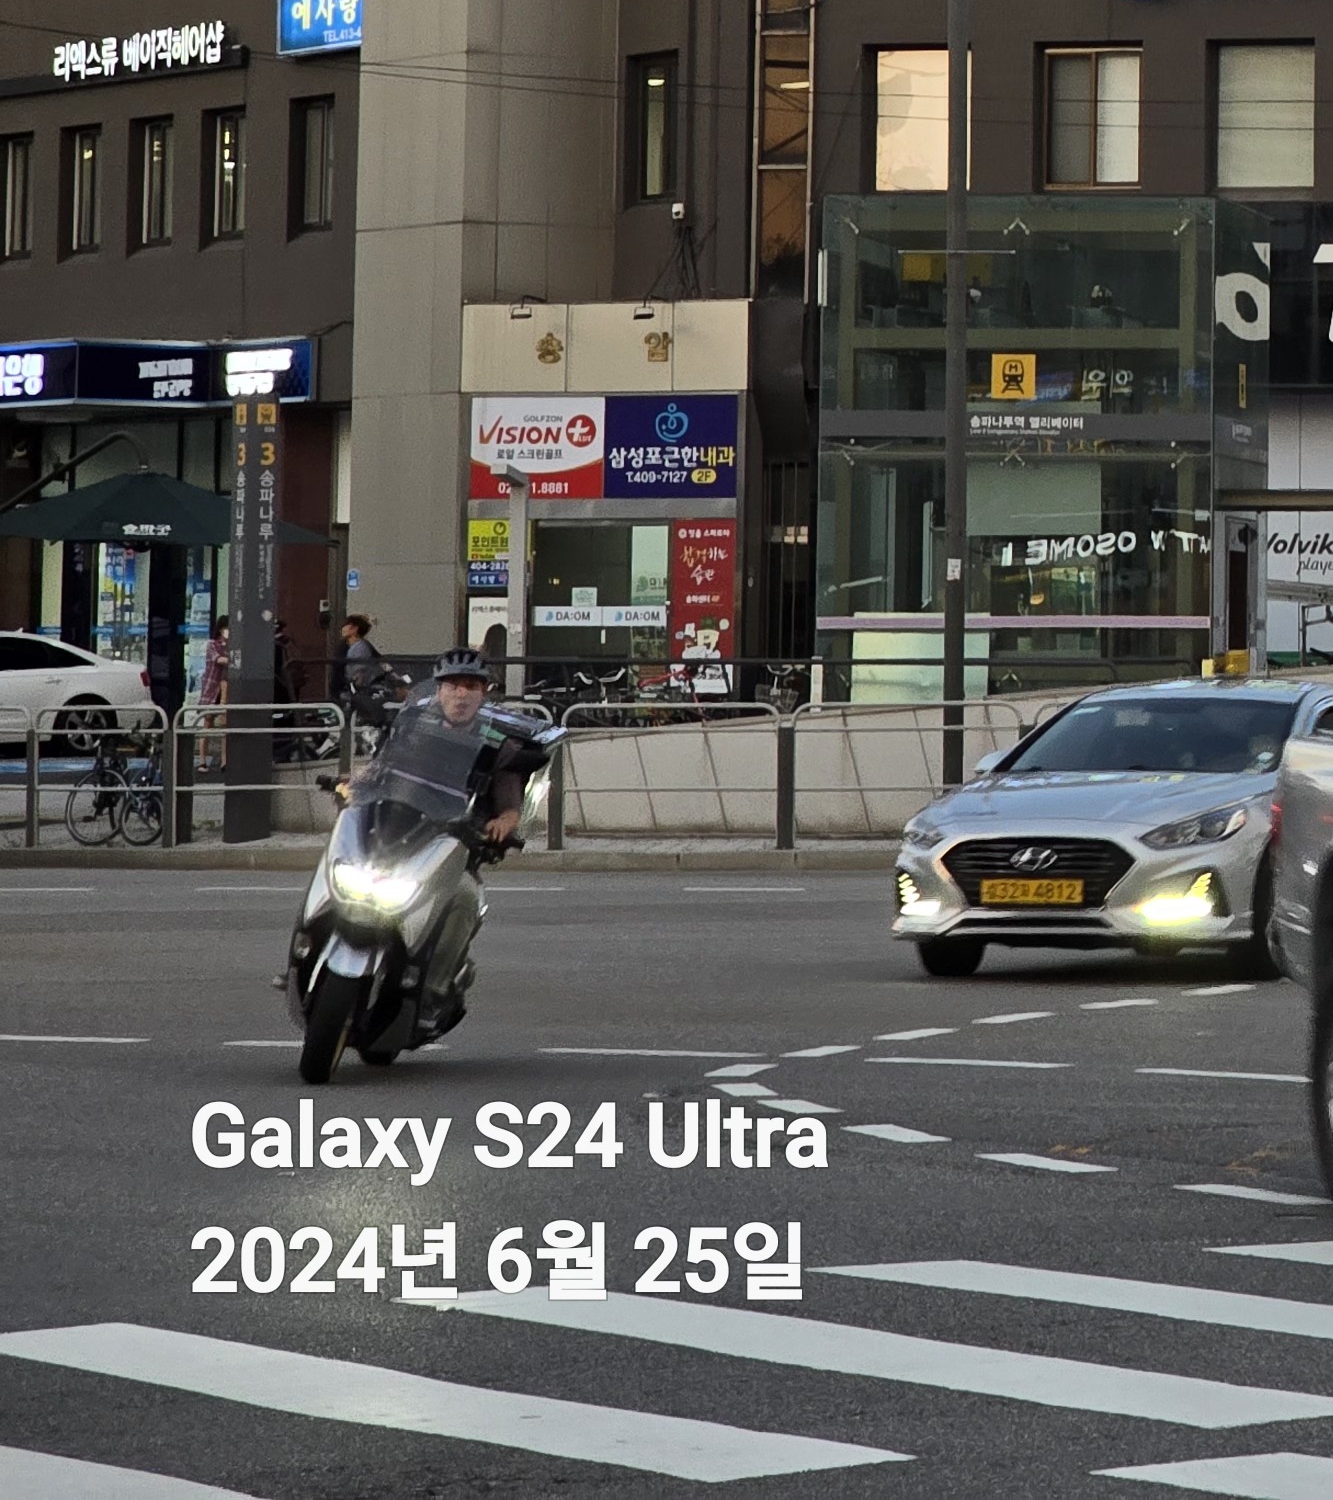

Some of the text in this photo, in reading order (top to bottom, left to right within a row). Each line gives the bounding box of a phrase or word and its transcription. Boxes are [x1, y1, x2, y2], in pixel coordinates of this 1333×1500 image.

[122, 19, 225, 72] 베이직헤어샵
[478, 415, 562, 445] VISION
[260, 442, 275, 466] 3
[696, 471, 712, 482] 2F
[258, 469, 275, 541] 송파나루
